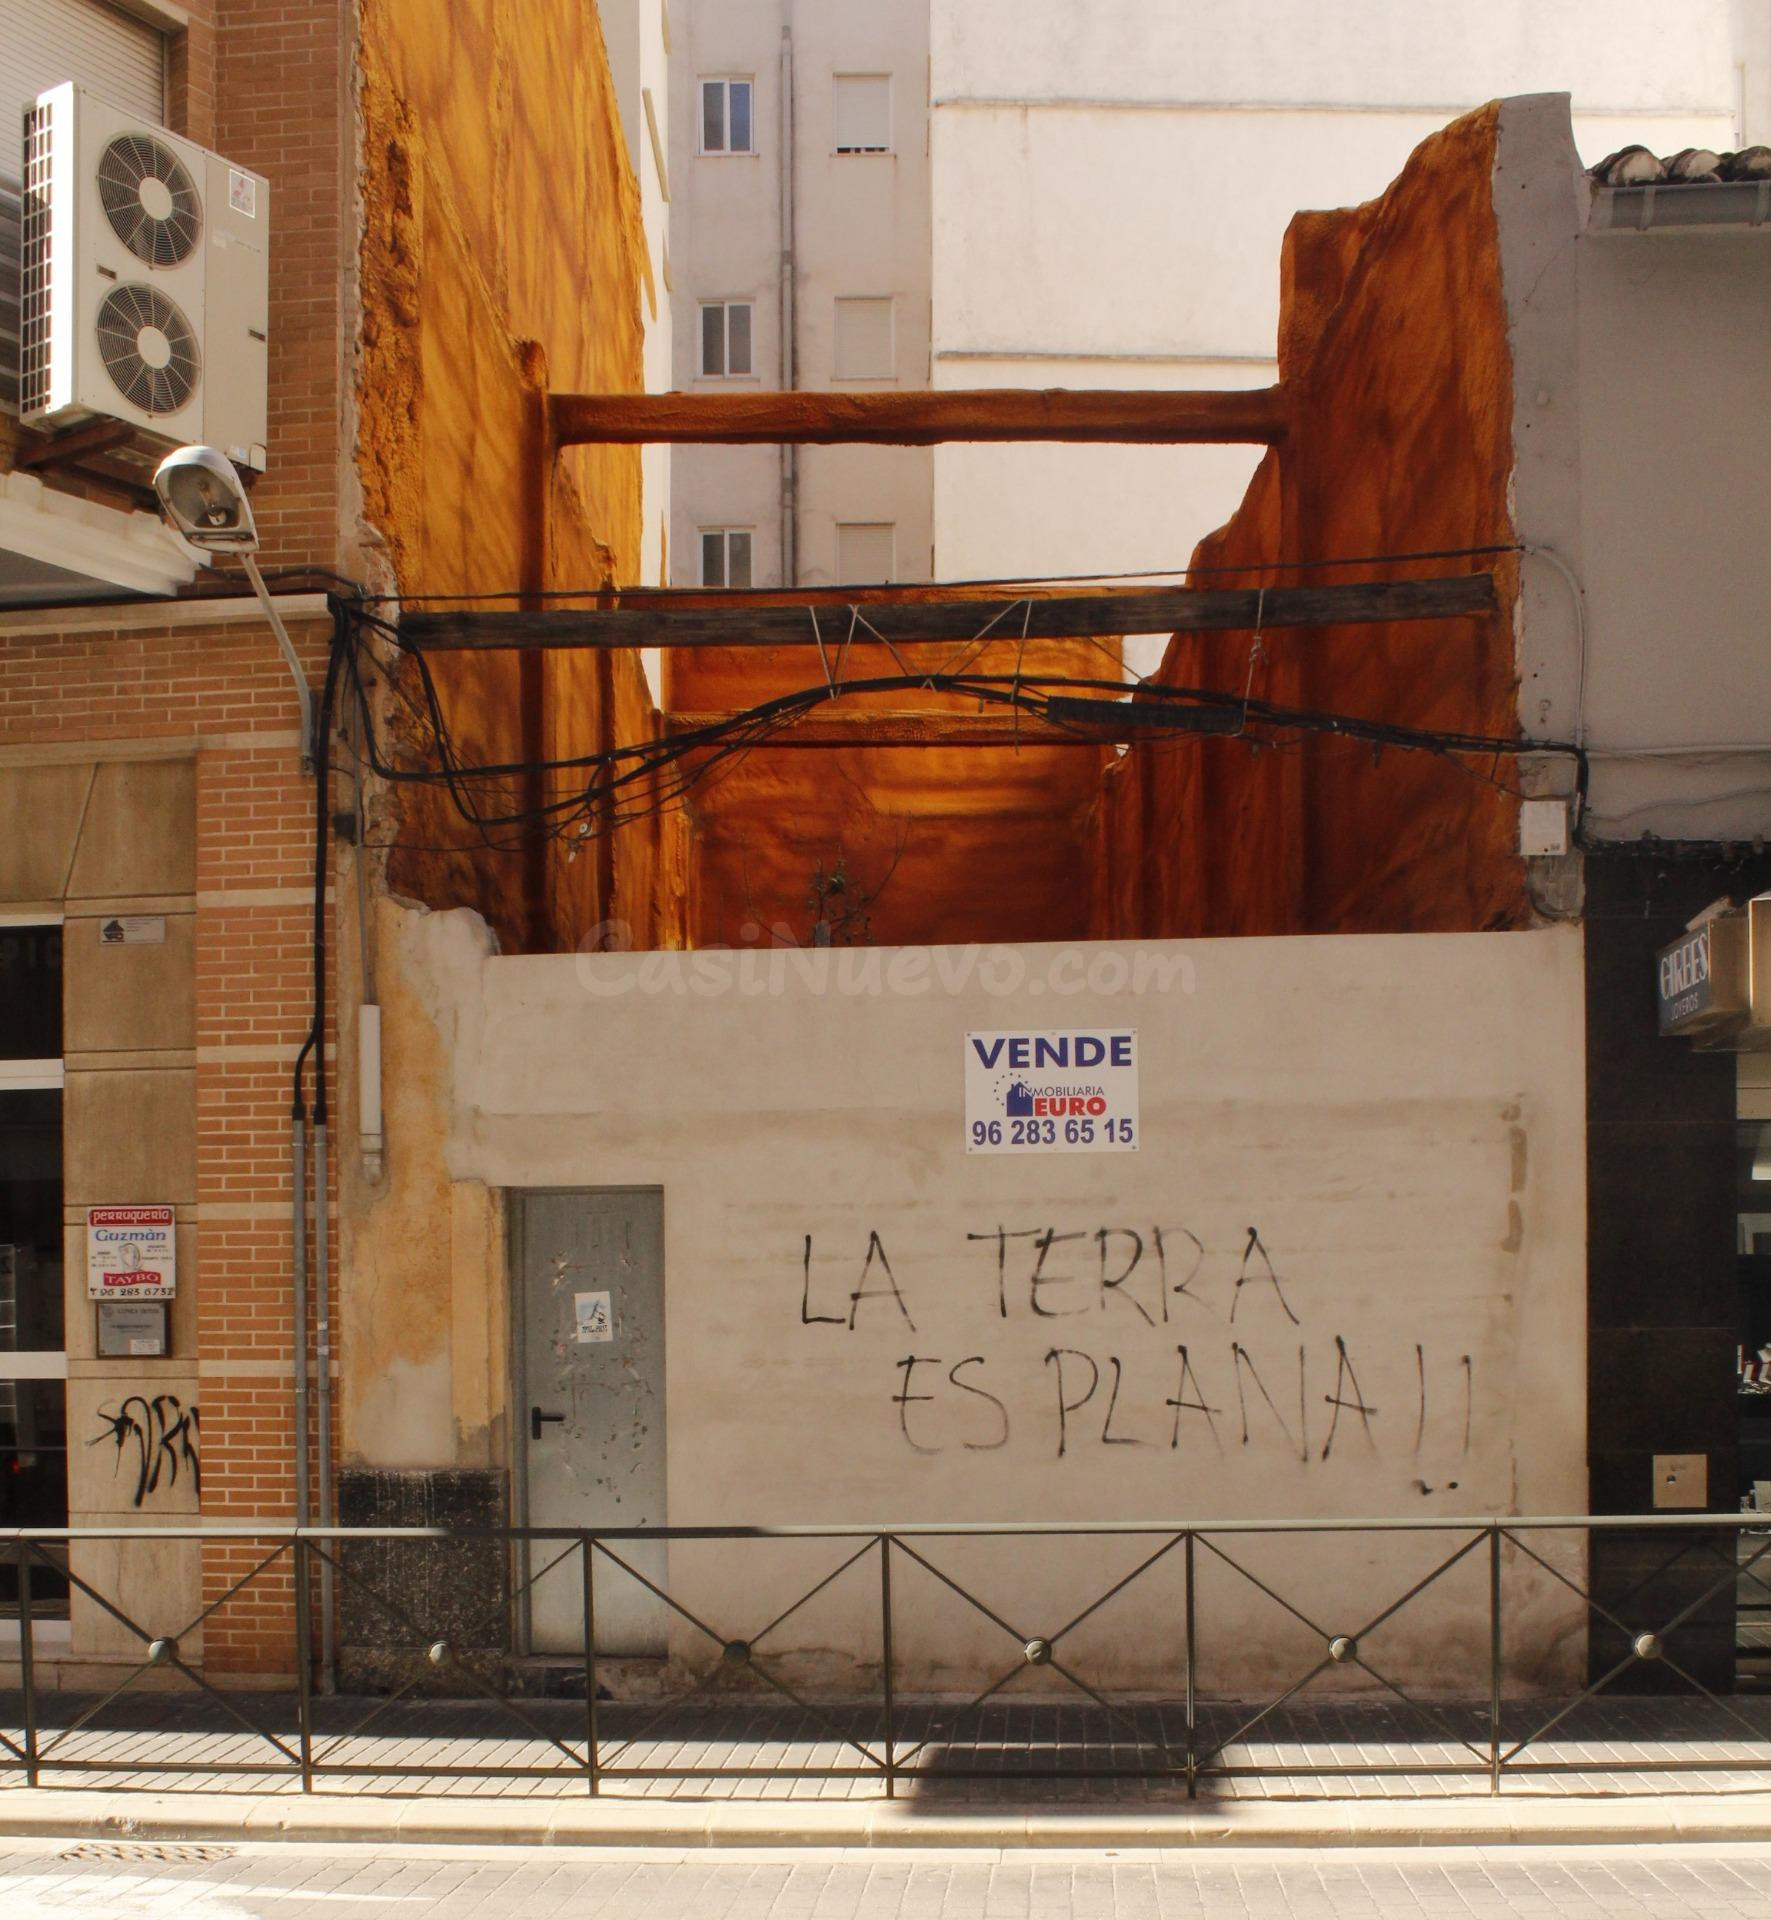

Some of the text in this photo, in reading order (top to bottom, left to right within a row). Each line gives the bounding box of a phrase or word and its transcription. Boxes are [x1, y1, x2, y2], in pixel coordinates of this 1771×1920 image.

[973, 1036, 1132, 1069] VENDE
[1018, 1086, 1105, 1098] INMOBILIARIA
[1035, 1098, 1107, 1117] EURO
[972, 1118, 1134, 1146] 96 283 65 15
[108, 1273, 159, 1285] TAYBO
[802, 1225, 1300, 1332] LA TERRA
[893, 1356, 1010, 1454] ES
